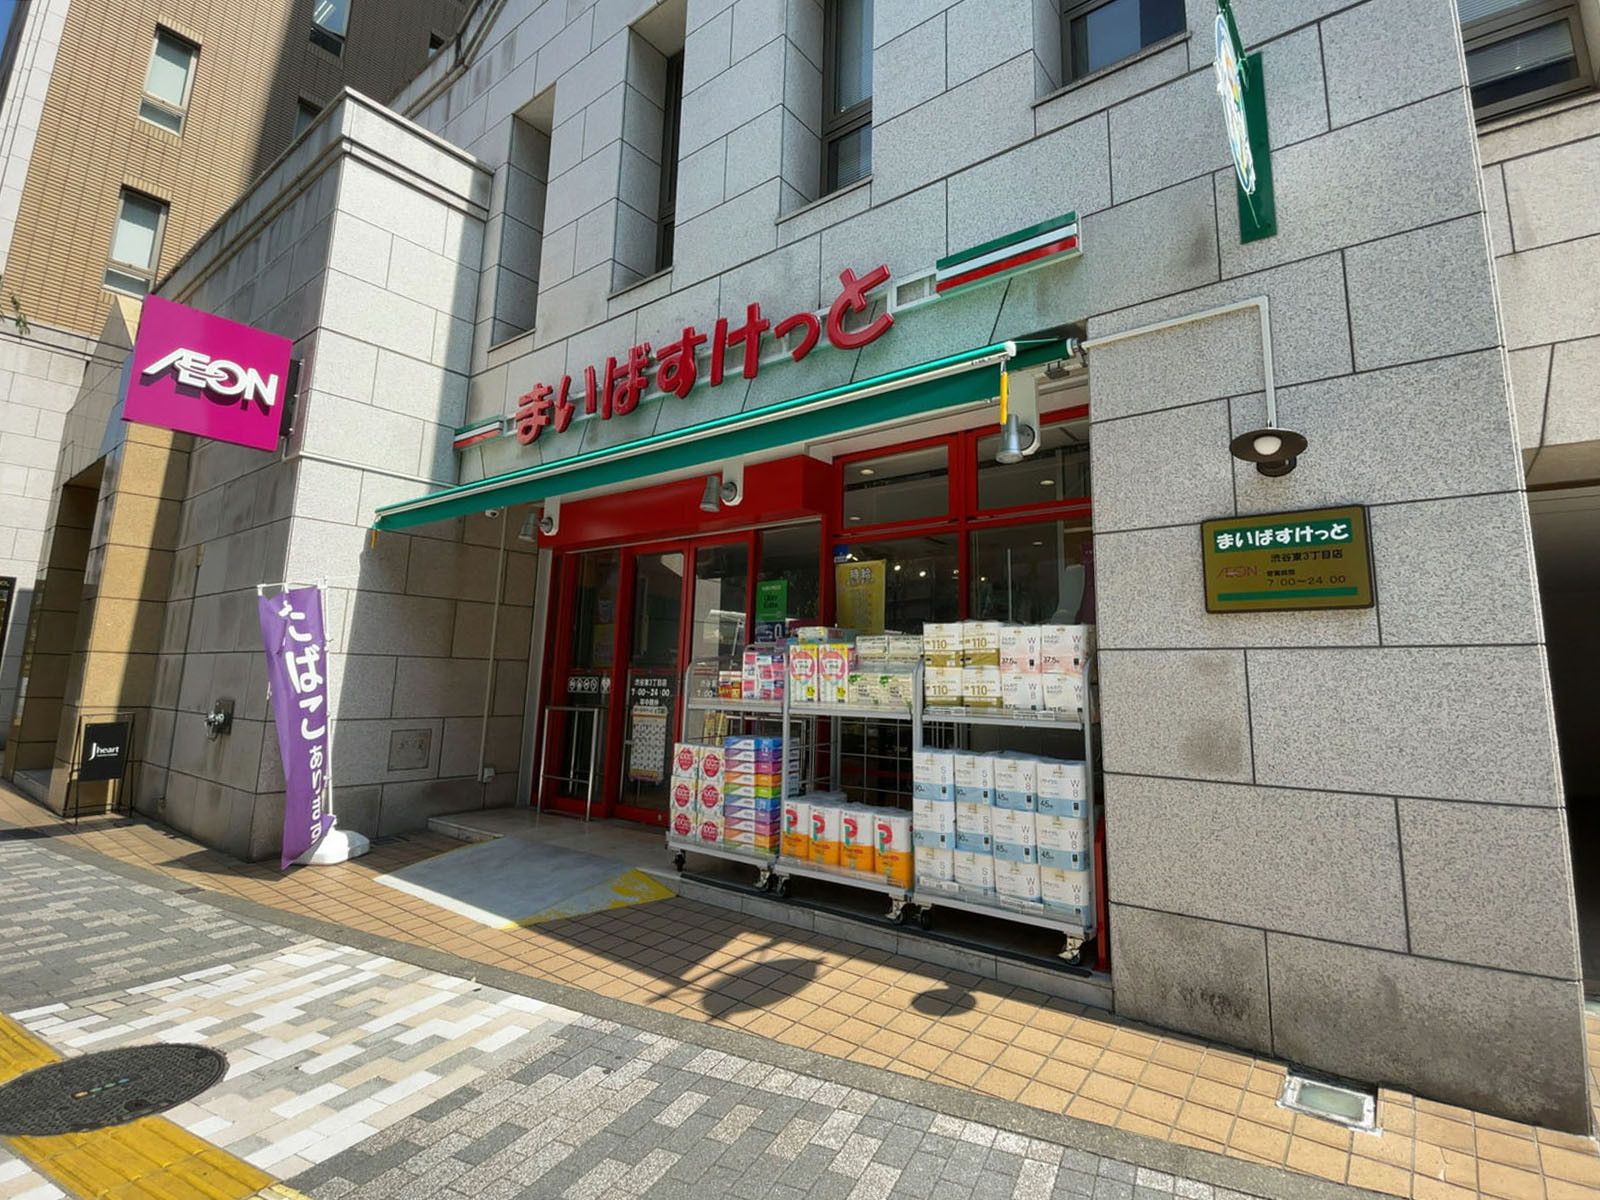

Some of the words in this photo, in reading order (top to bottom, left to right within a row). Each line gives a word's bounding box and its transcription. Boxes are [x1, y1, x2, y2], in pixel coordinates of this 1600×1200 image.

[515, 264, 895, 446] まいばすけっと
[143, 347, 279, 406] AEON
[1216, 523, 1350, 549] まいばすけっと
[932, 639, 947, 649] 110
[971, 637, 987, 648] 110
[932, 685, 948, 695] 110
[971, 684, 988, 695] 110
